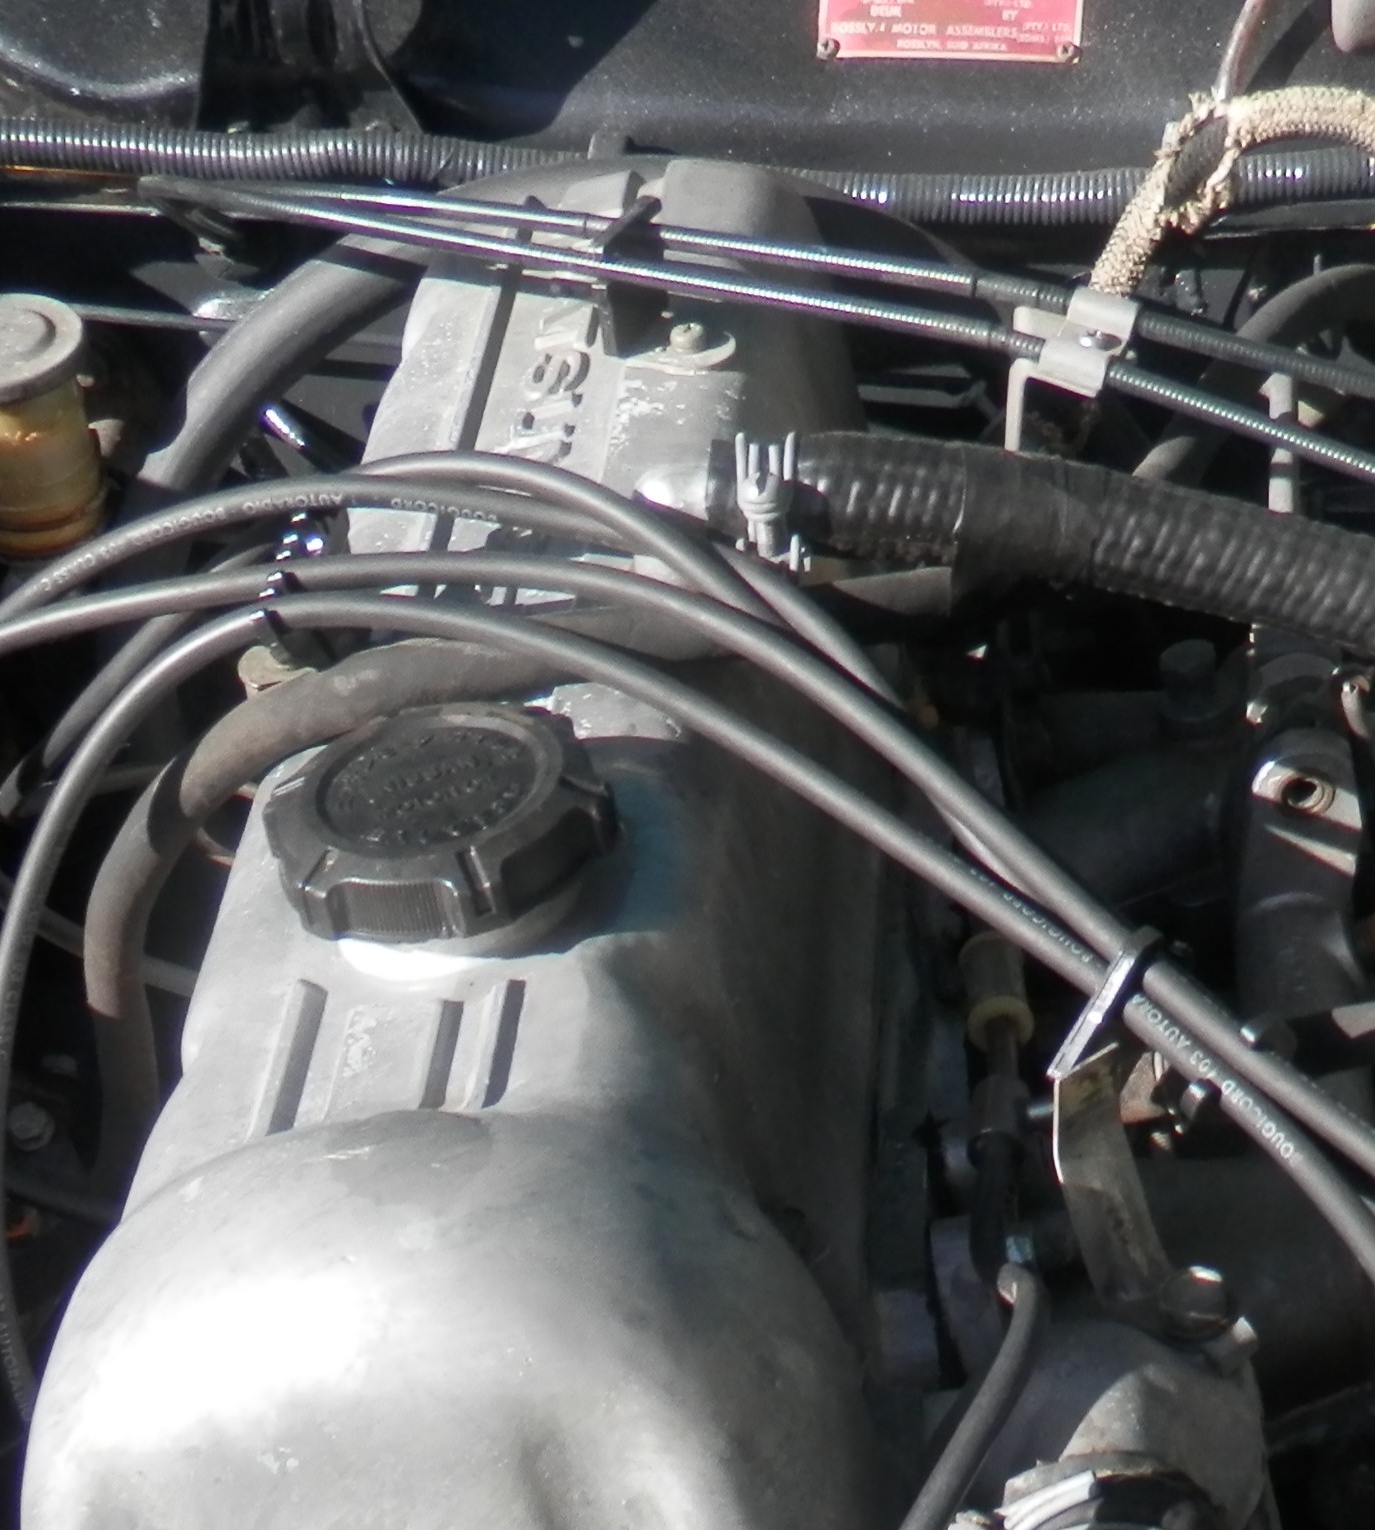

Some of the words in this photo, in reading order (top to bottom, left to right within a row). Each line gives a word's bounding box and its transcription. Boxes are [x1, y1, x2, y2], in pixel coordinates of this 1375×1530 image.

[1002, 10, 1018, 20] BY
[891, 24, 937, 35] MOTOR
[945, 24, 1018, 40] ASSEMBLERS
[243, 493, 343, 515] AUTORADIO
